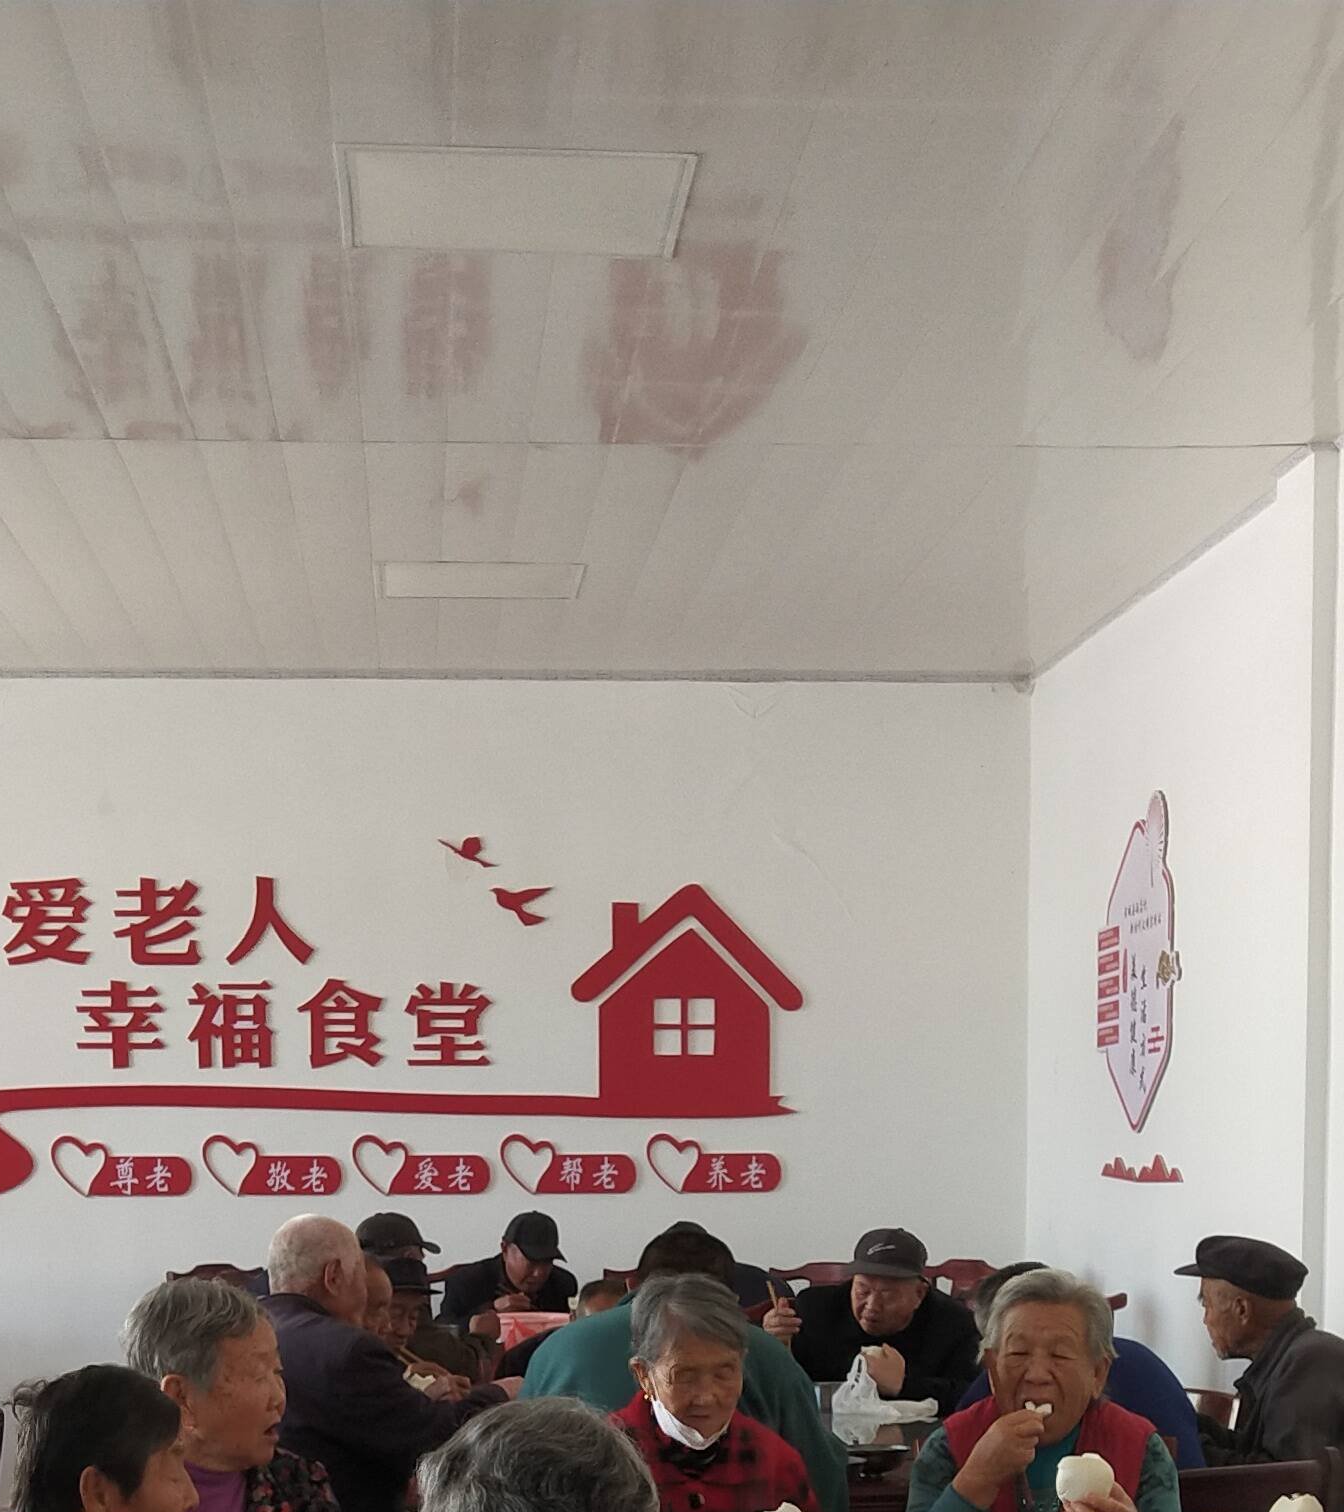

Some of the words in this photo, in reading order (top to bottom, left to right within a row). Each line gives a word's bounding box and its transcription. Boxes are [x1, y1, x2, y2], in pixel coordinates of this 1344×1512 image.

[75, 979, 495, 1070] 幸福食堂
[110, 1158, 172, 1194] 尊老
[266, 1159, 329, 1193] 敬老
[412, 1158, 475, 1193] 爱老
[558, 1156, 620, 1192] 帮老
[705, 1156, 768, 1192] 养老
